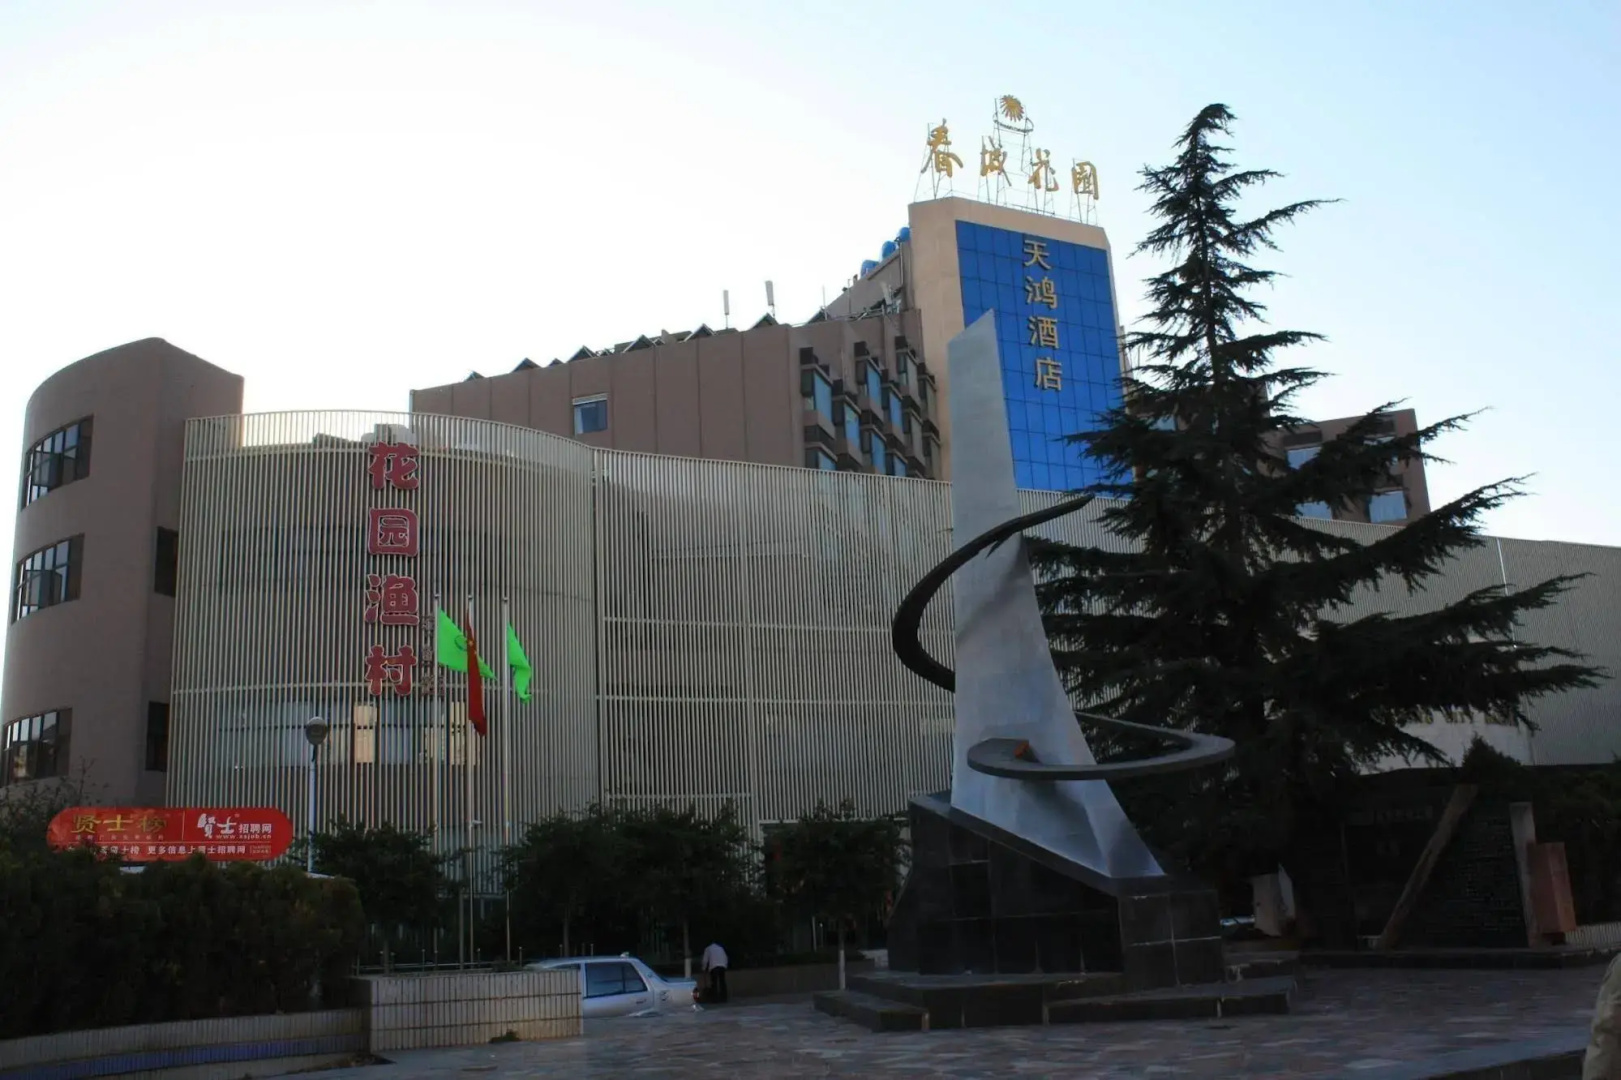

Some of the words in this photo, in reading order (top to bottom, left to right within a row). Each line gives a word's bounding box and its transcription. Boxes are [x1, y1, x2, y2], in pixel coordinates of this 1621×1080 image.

[1023, 239, 1063, 391] 天鸿酒店
[364, 441, 420, 696] 花园渔村
